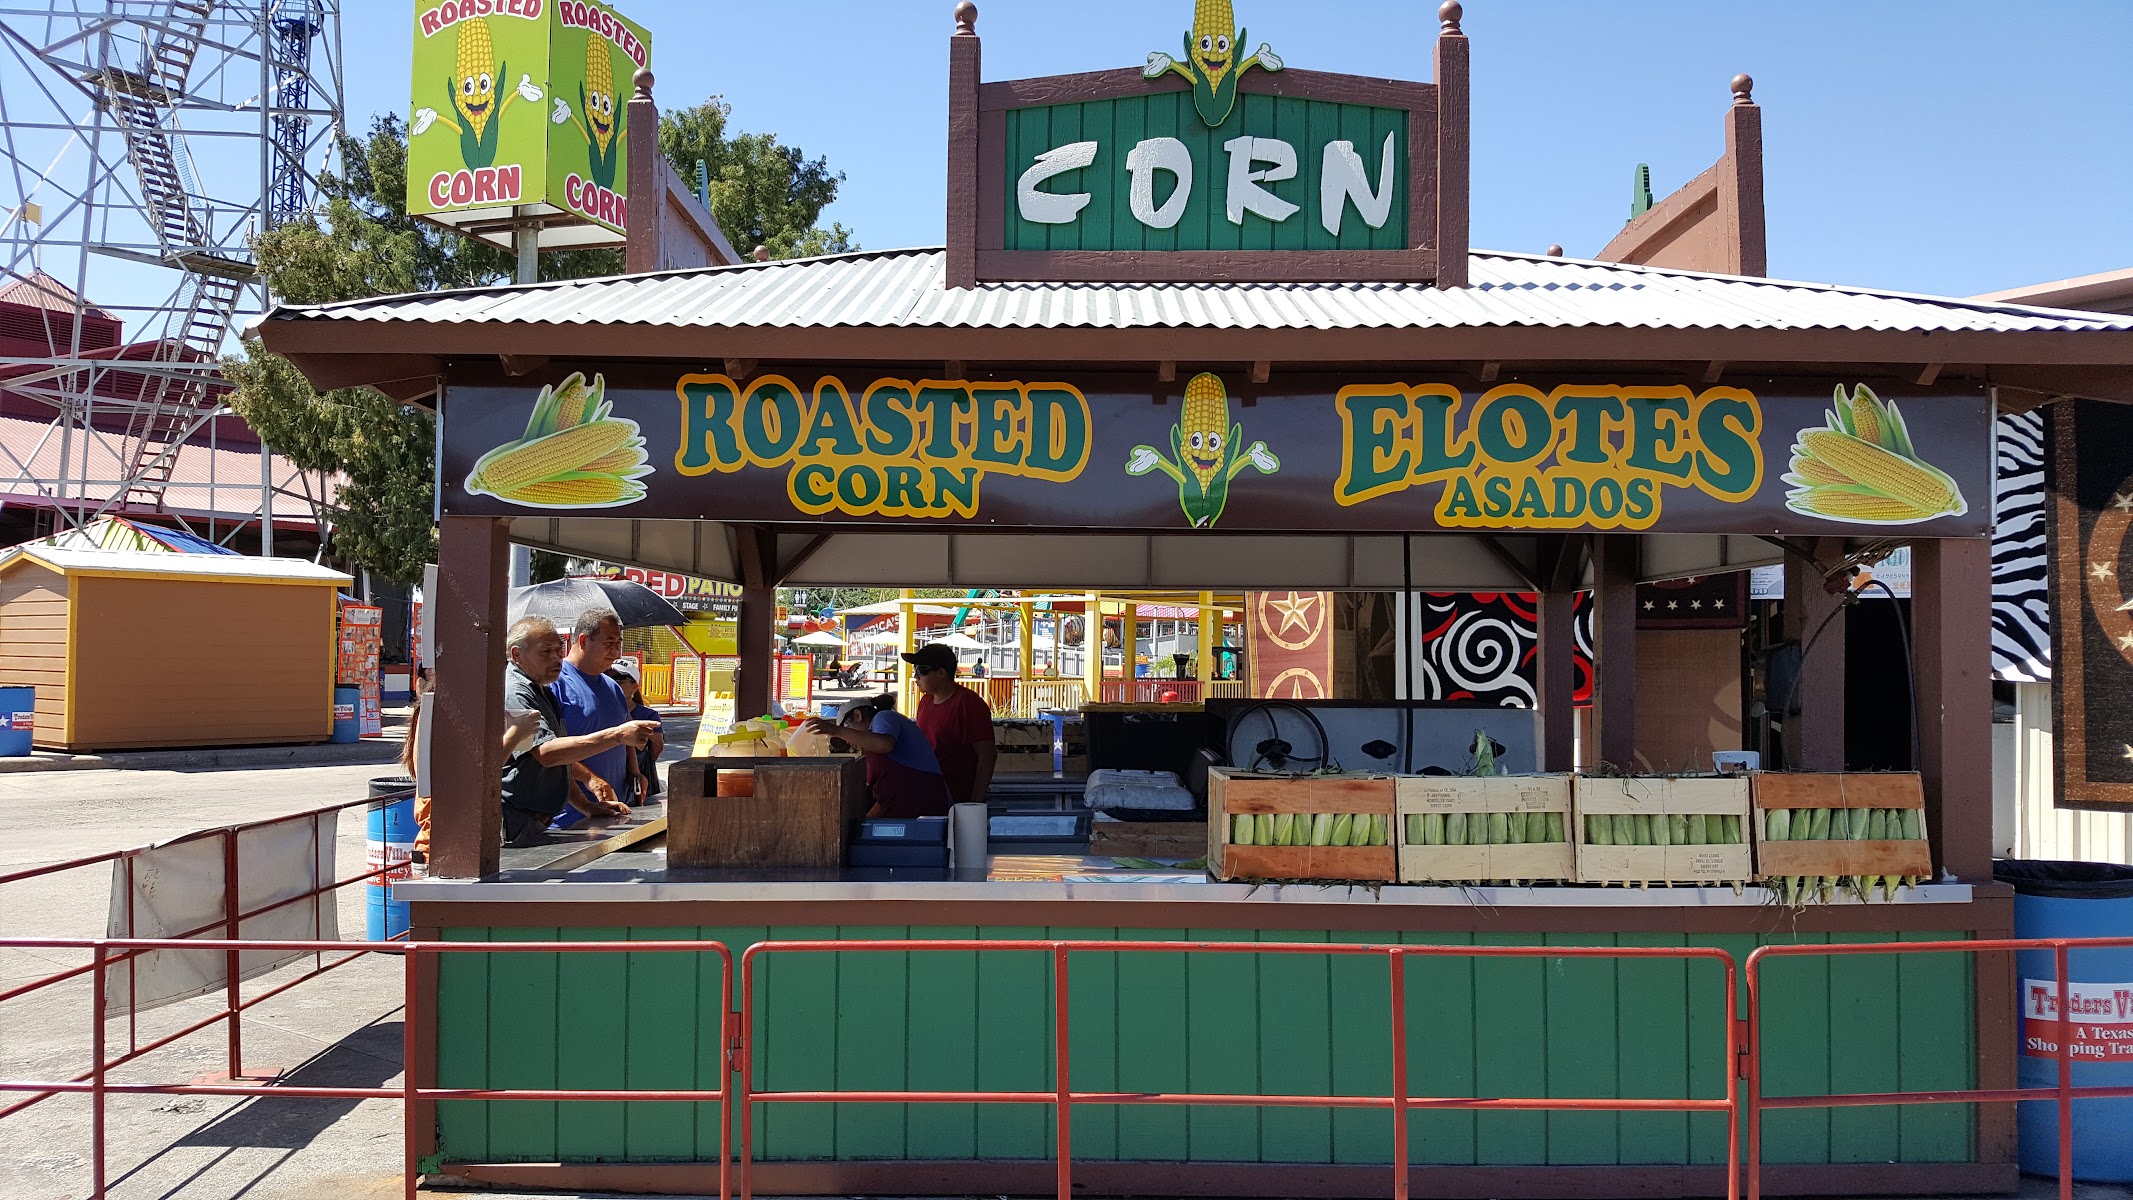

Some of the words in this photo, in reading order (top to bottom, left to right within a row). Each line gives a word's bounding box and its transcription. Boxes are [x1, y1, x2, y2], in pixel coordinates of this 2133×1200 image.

[559, 1, 647, 68] ROASTED
[428, 164, 522, 208] CORN
[565, 173, 627, 231] CORN
[1017, 130, 1394, 236] CORN
[677, 376, 1091, 480] ROASTED
[1340, 387, 1760, 501] ELOTES
[790, 461, 981, 514] CORN
[1440, 472, 1658, 524] ASADOS
[682, 602, 699, 610] STAGE
[2031, 986, 2112, 1016] Trders
[2027, 1037, 2105, 1058] Shoping
[2076, 1026, 2088, 1039] A
[2091, 1027, 2133, 1040] Texas
